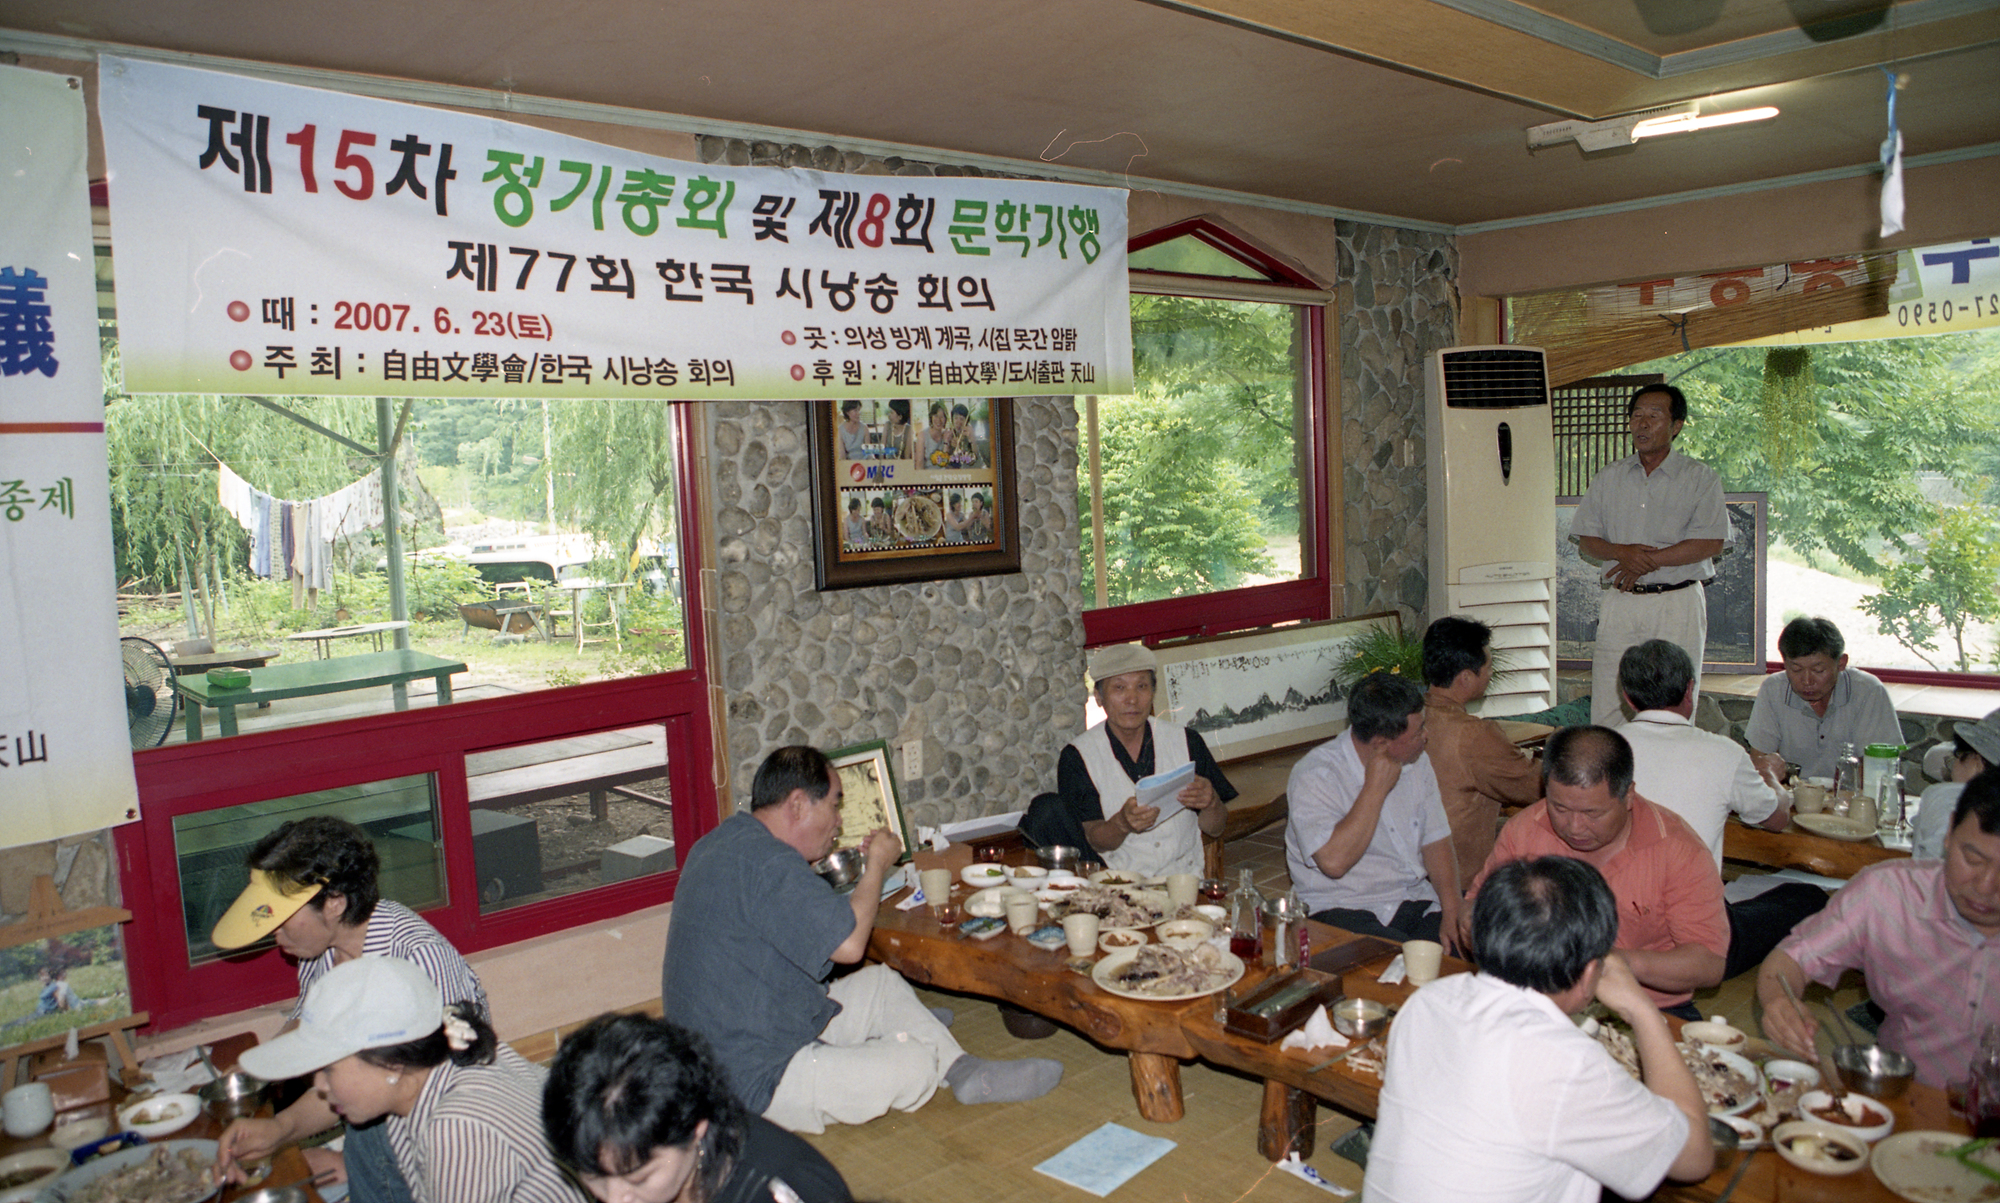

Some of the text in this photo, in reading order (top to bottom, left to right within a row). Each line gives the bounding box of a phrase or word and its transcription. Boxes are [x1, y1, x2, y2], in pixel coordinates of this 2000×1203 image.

[196, 104, 1101, 266] 제15차 정기총회 및 제8회 문학기행
[446, 240, 996, 314] 제77회 한국 시낭송 회의
[471, 310, 553, 342] 23(토)
[844, 325, 888, 351] 의성
[889, 325, 933, 351] 빙계
[934, 325, 973, 352] 계곡,
[978, 326, 1012, 352] 시집
[1013, 327, 1048, 351] 못간
[1050, 327, 1078, 352] 암탉
[603, 355, 679, 387] 시낭송
[687, 358, 735, 387] 회의
[1070, 362, 1095, 384] 天山
